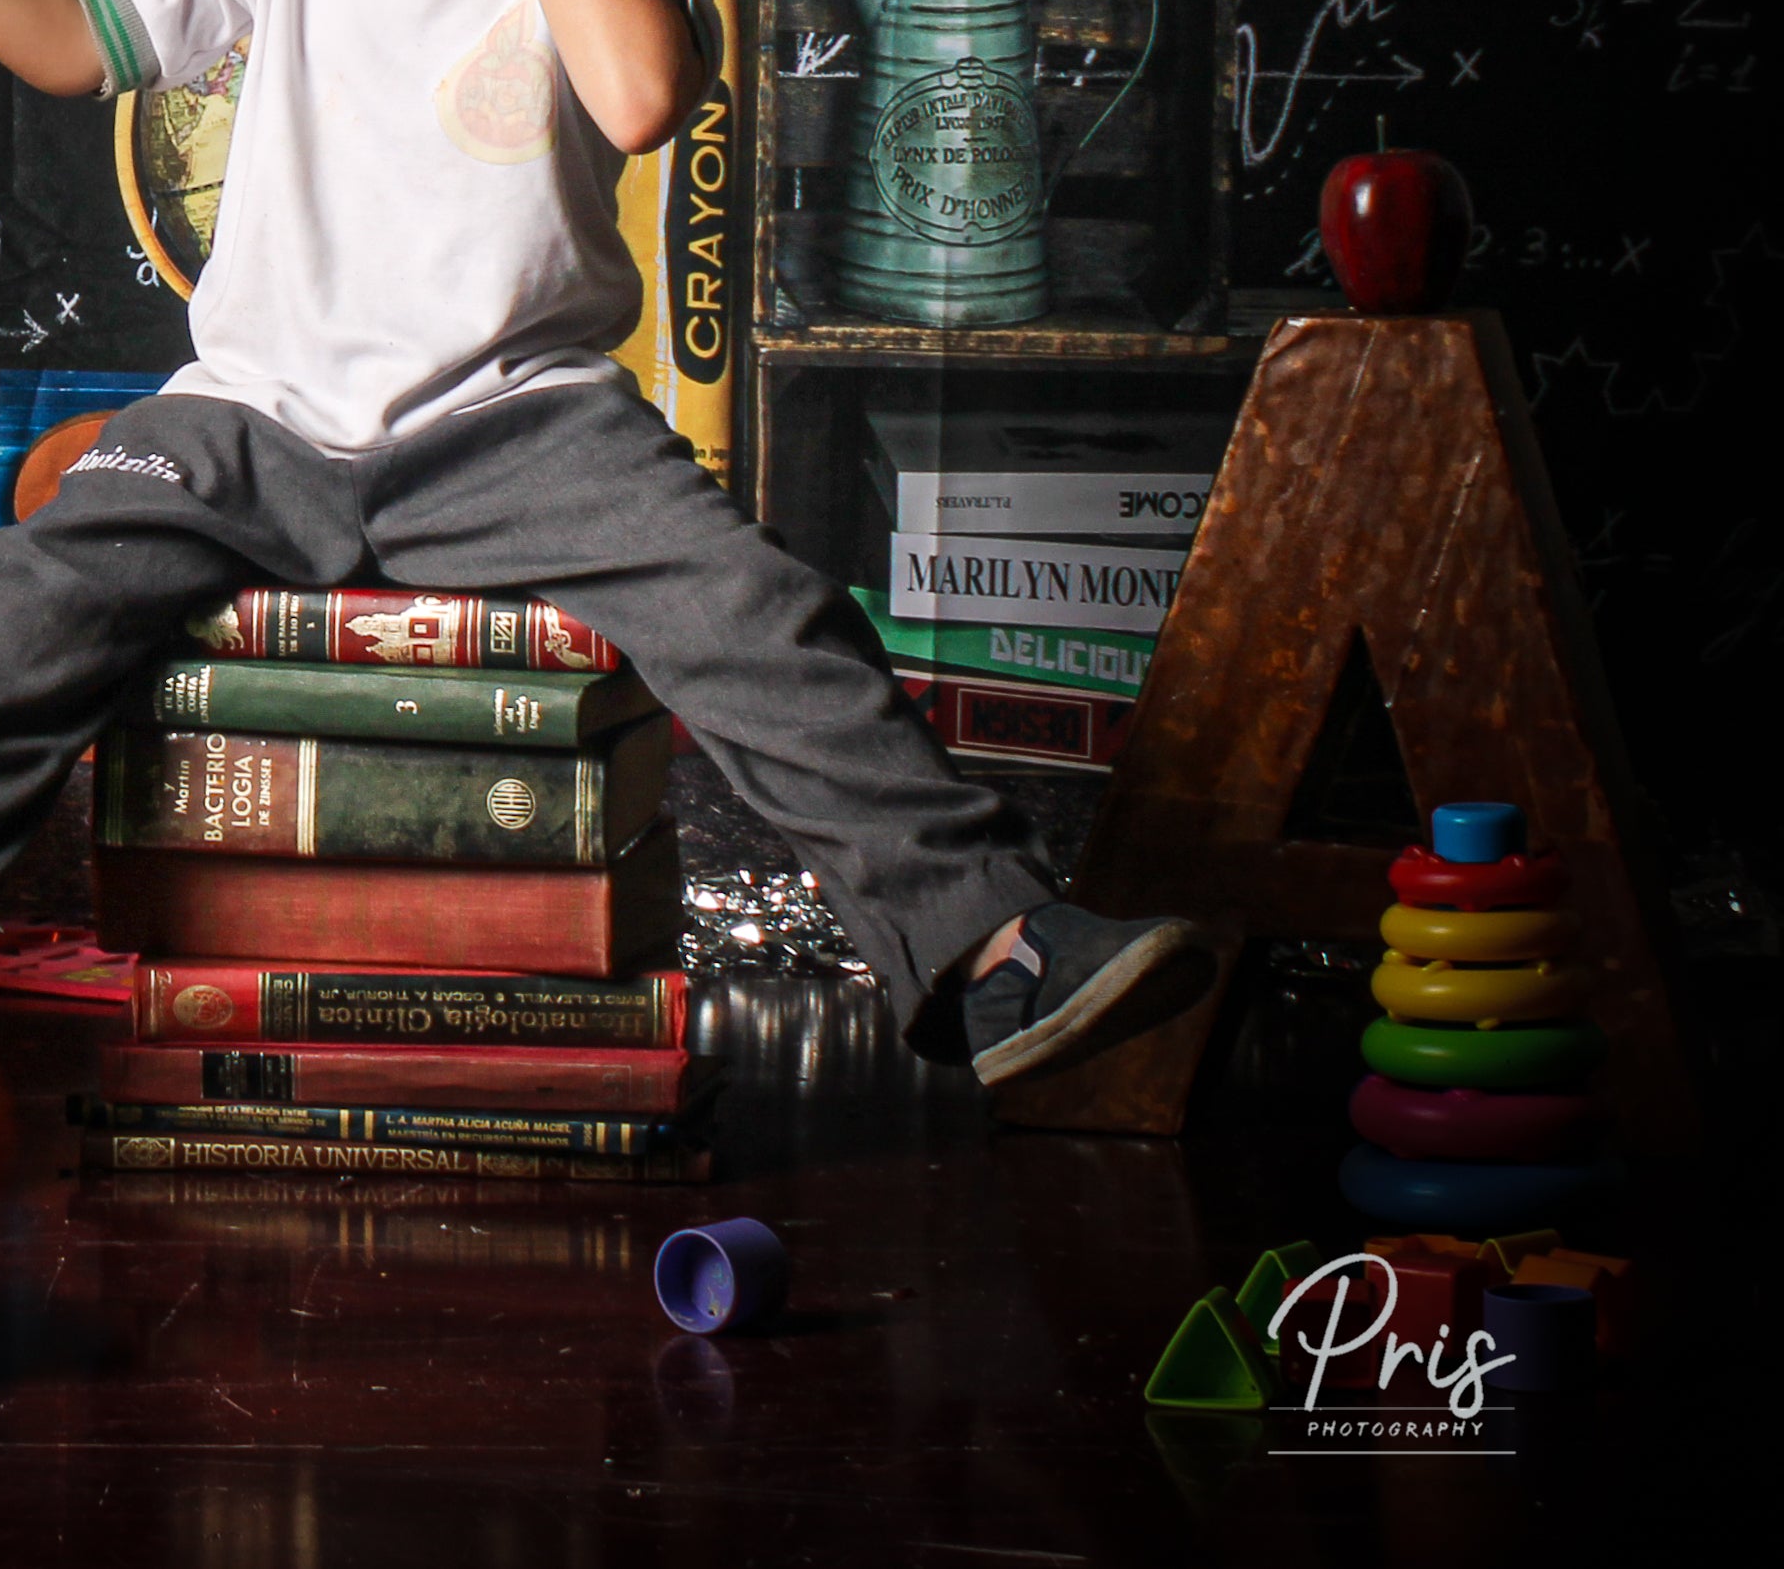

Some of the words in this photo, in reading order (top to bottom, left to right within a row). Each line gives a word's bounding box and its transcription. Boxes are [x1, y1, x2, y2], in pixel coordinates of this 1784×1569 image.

[893, 146, 939, 164] LYNX
[943, 146, 966, 164] DE
[890, 165, 935, 209] PRIX
[685, 100, 729, 361] CRAYON
[1118, 491, 1212, 519] COME
[906, 552, 1071, 603] MARILYN
[395, 697, 418, 716] 3
[173, 759, 191, 815] Martin
[203, 732, 227, 843] BACTERIO
[231, 755, 254, 828] LOGIA
[258, 758, 273, 807] ZINSSER
[258, 809, 272, 826] DE
[432, 990, 486, 1003] OSCAR
[317, 1005, 434, 1035] Clínica
[412, 1115, 455, 1128] MARTHA
[457, 1117, 491, 1130] ALICIA
[532, 1121, 573, 1134] MACIEL
[181, 1141, 312, 1168] HISTORIA
[314, 1143, 472, 1171] UNIVERSAL
